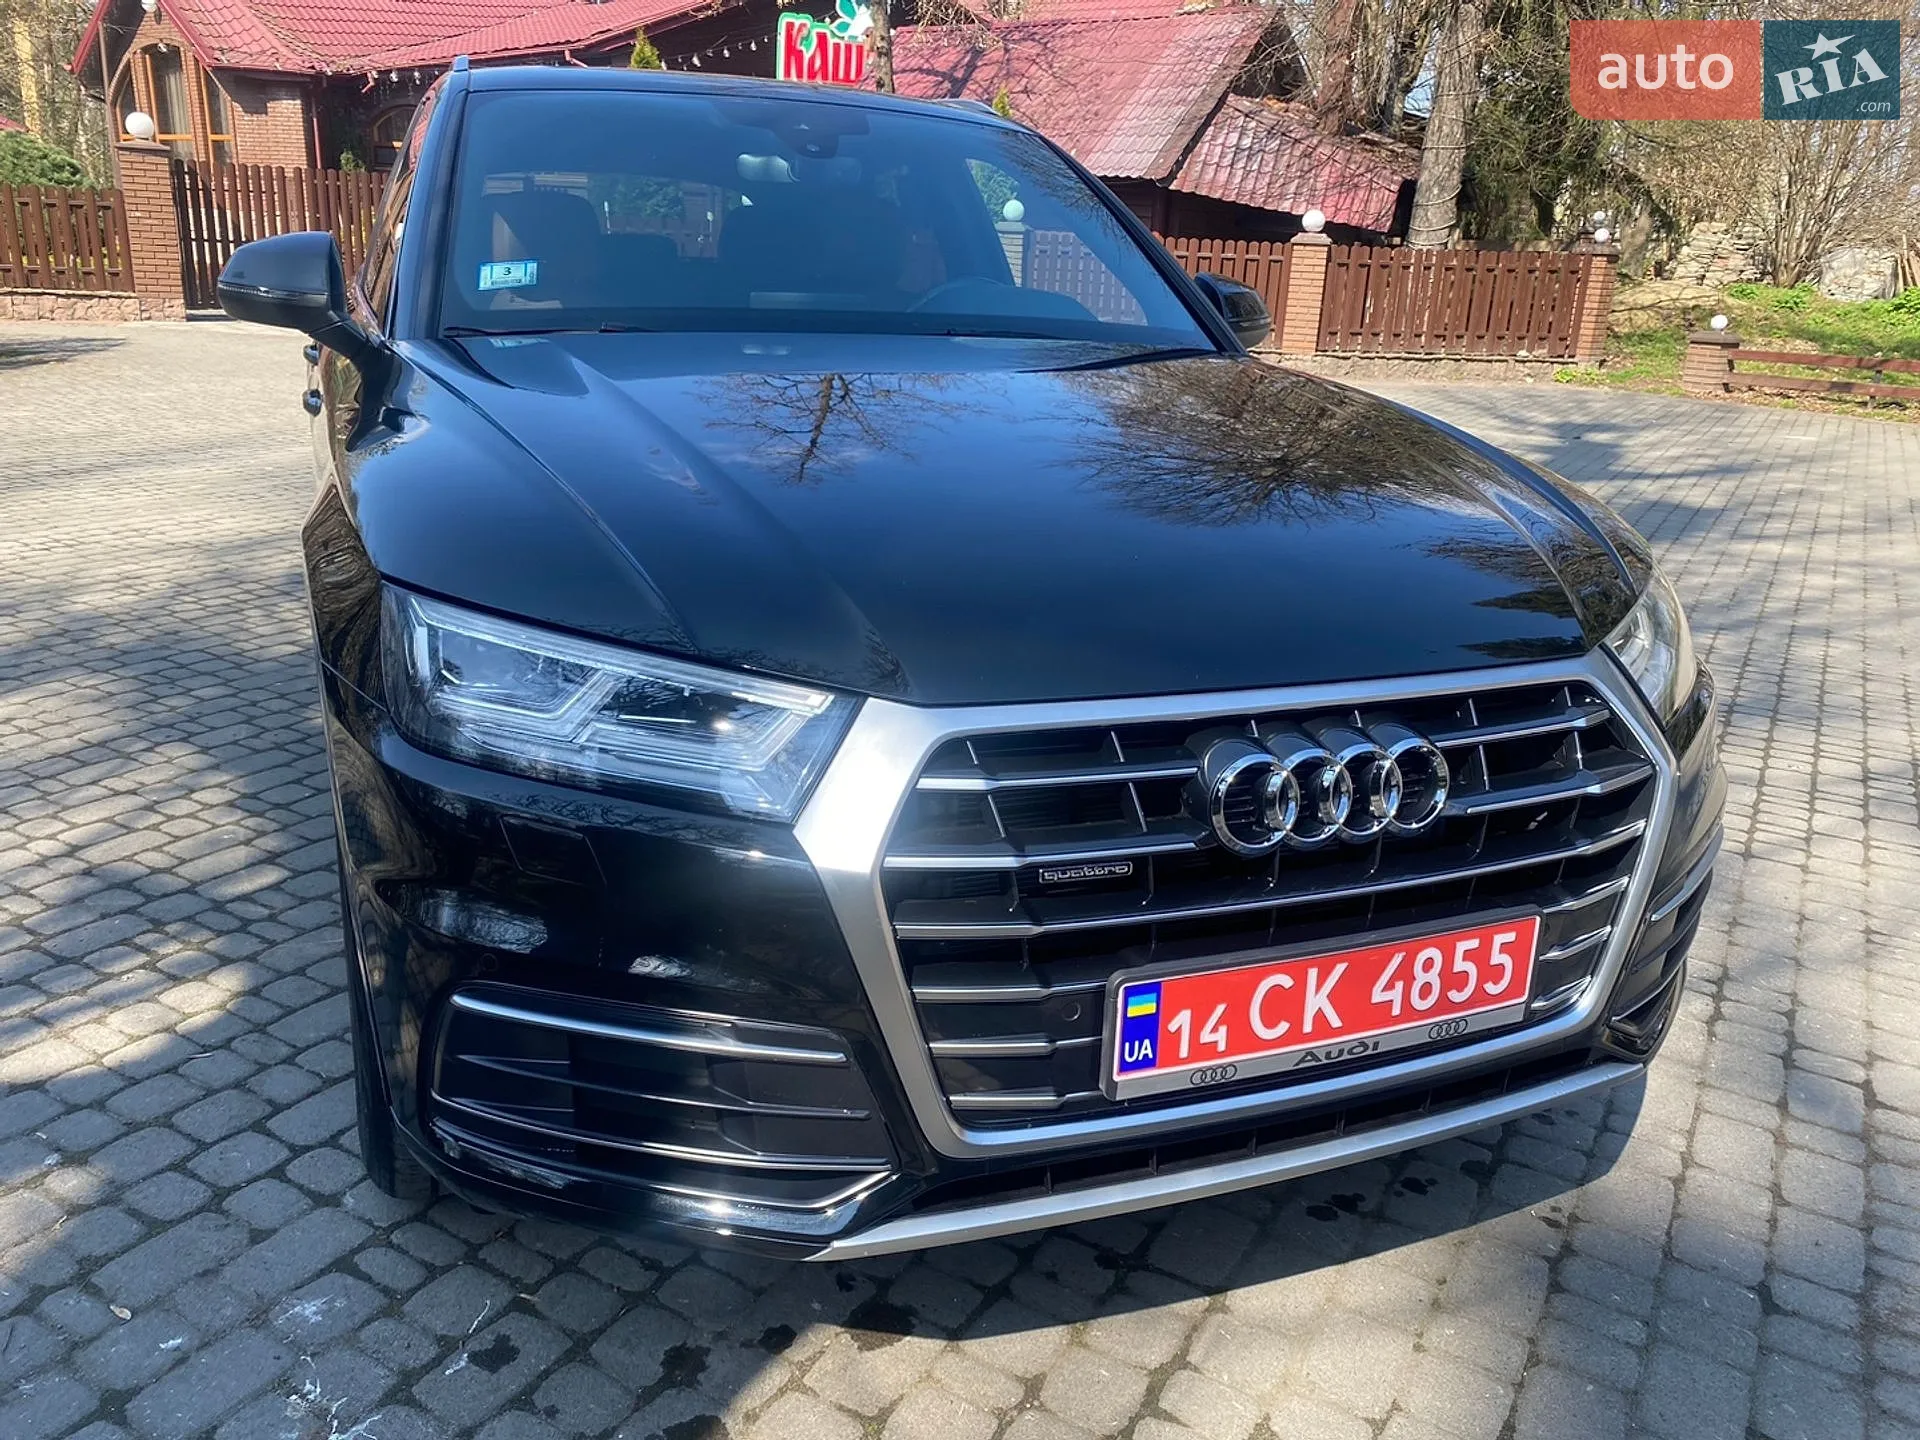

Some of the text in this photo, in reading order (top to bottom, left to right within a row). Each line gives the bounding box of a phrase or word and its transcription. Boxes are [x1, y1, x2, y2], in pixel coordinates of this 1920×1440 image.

[503, 266, 512, 276] 3
[1043, 864, 1129, 881] quattro
[1167, 931, 1518, 1060] 14 CK 4855
[1124, 1039, 1153, 1063] UA
[1293, 1040, 1381, 1068] Audi
